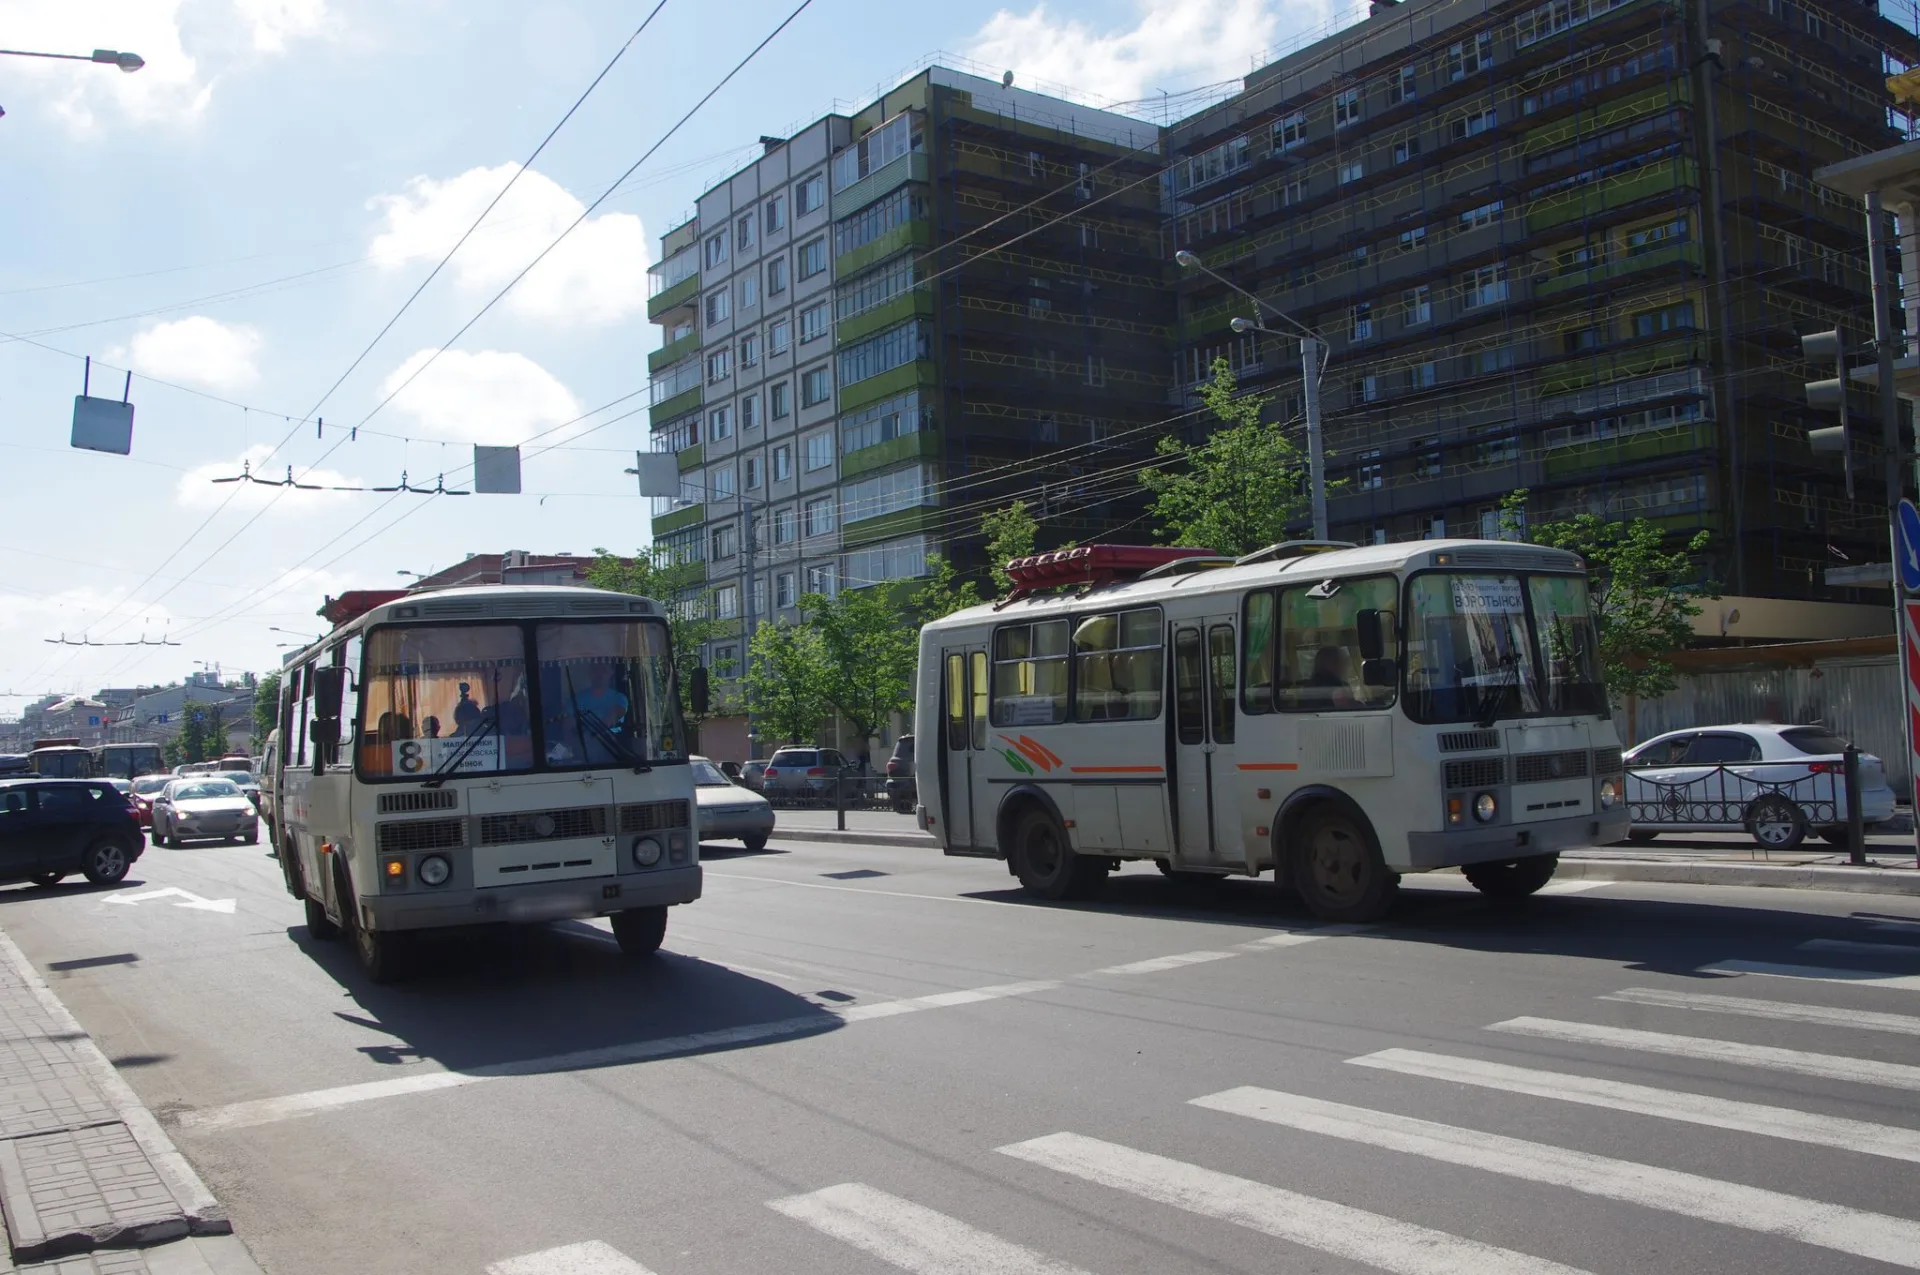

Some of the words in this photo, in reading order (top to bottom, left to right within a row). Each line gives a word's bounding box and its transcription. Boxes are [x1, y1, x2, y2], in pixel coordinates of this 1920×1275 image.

[1454, 595, 1522, 608] ВОРОТЫНСК
[399, 741, 424, 773] 8
[457, 760, 484, 768] ЫНОК
